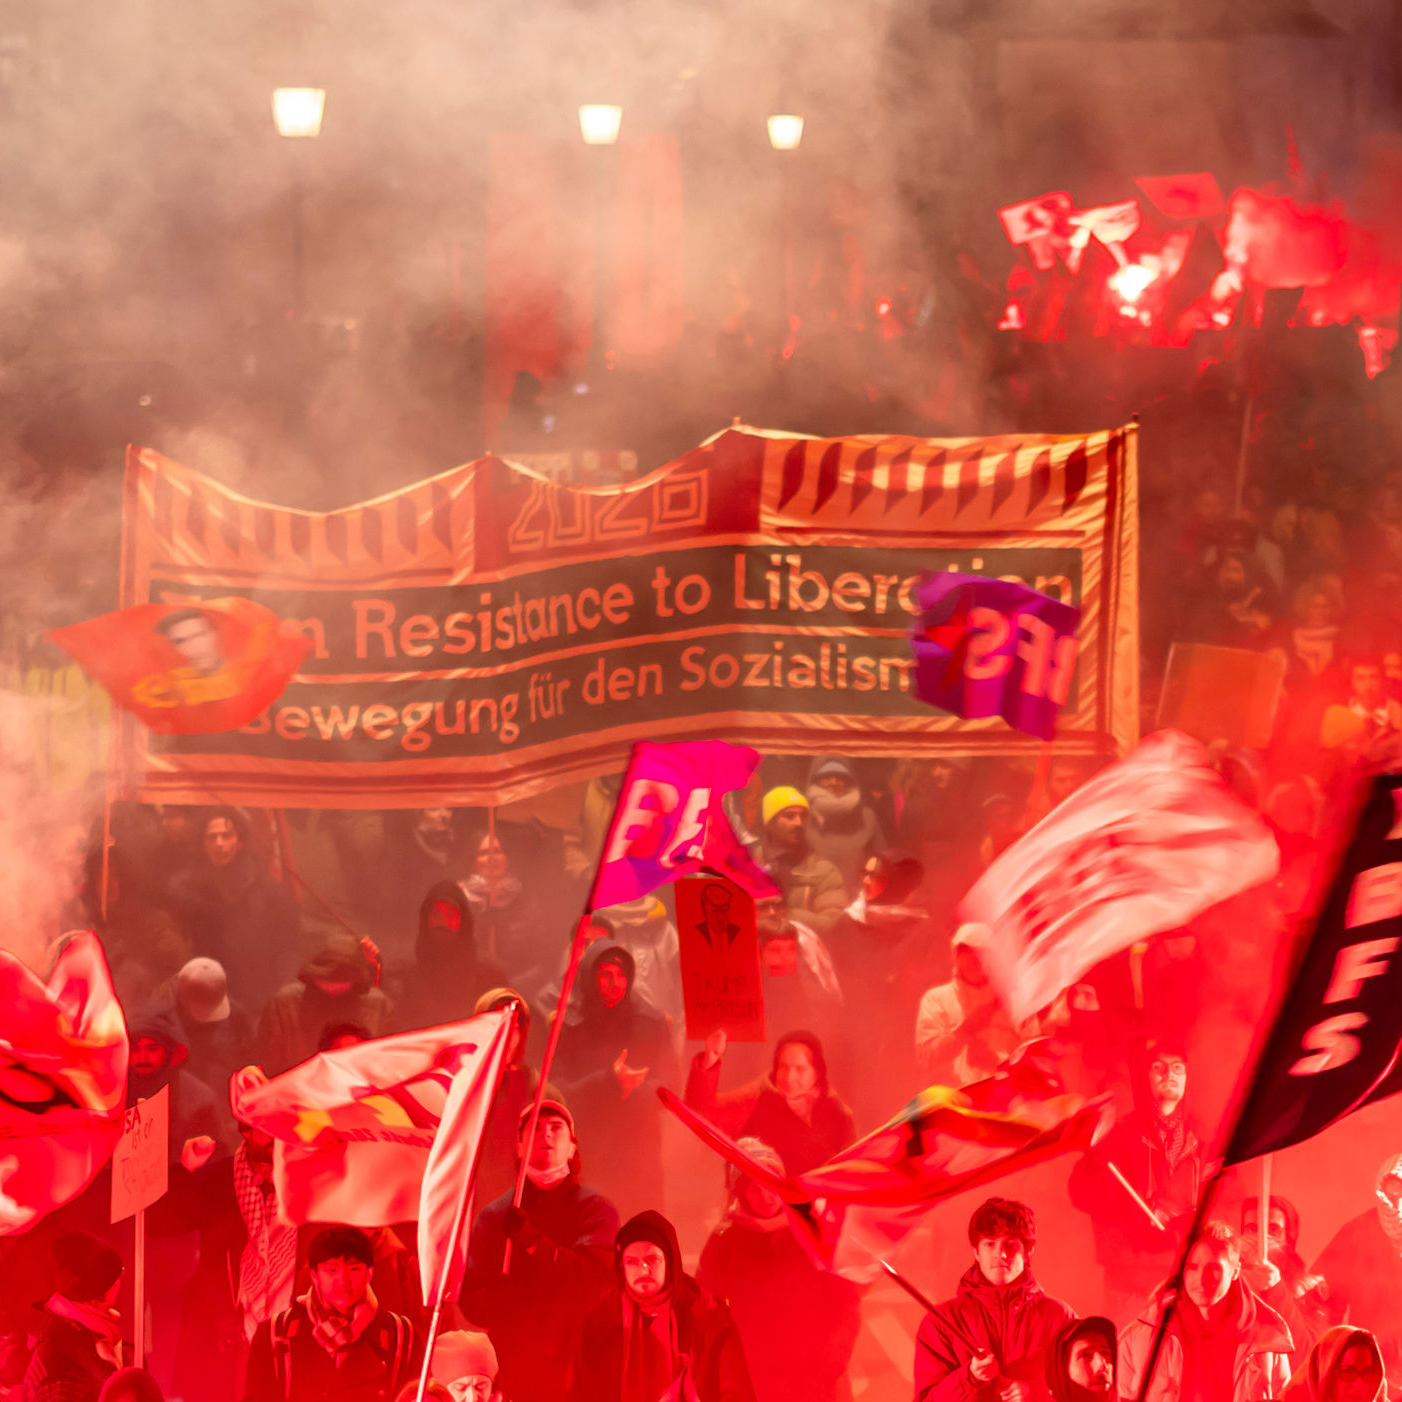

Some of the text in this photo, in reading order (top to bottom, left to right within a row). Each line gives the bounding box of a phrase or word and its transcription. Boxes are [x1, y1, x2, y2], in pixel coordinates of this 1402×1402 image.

[351, 582, 635, 659] Resistance
[651, 565, 712, 618] to
[528, 671, 571, 723] für
[581, 656, 663, 705] den
